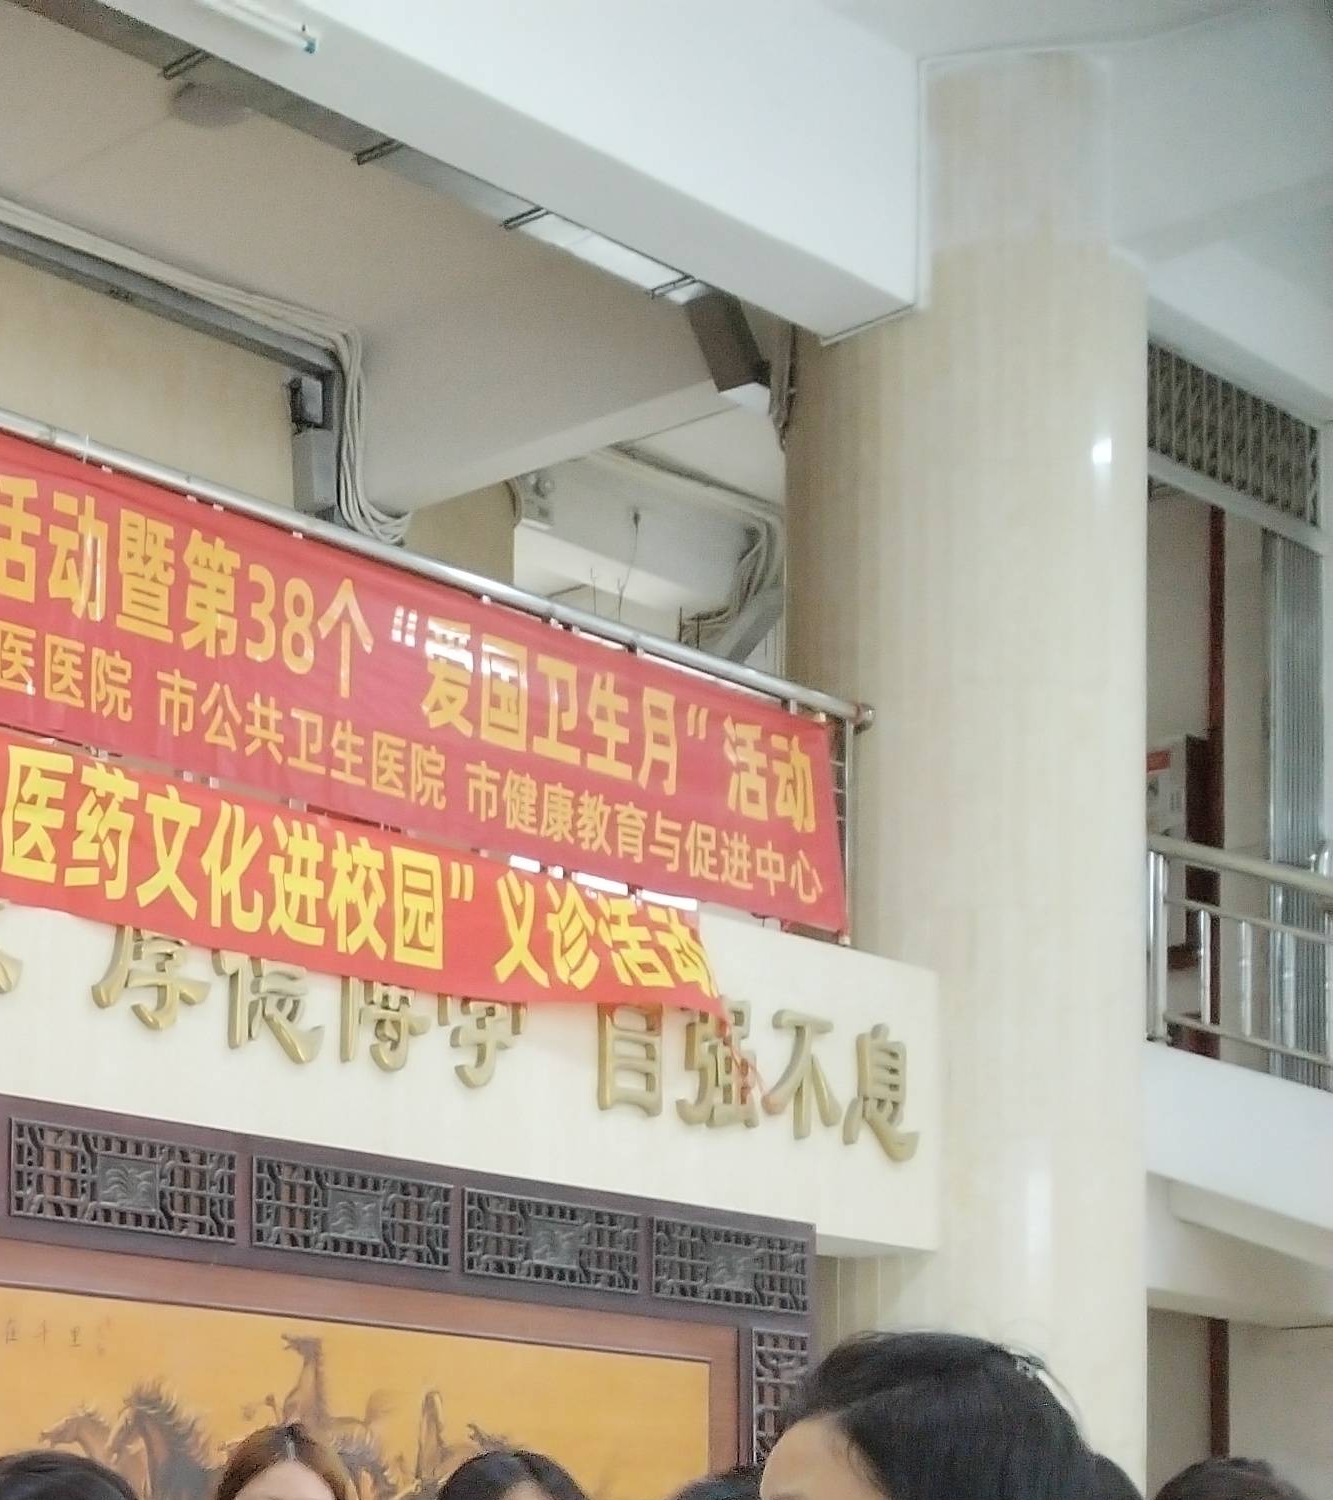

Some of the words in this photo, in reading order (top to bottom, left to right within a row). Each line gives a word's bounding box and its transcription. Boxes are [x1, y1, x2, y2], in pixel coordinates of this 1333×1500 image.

[156, 667, 447, 812] 市公共卫生医院
[467, 761, 824, 906] 市健康教育与促进中心
